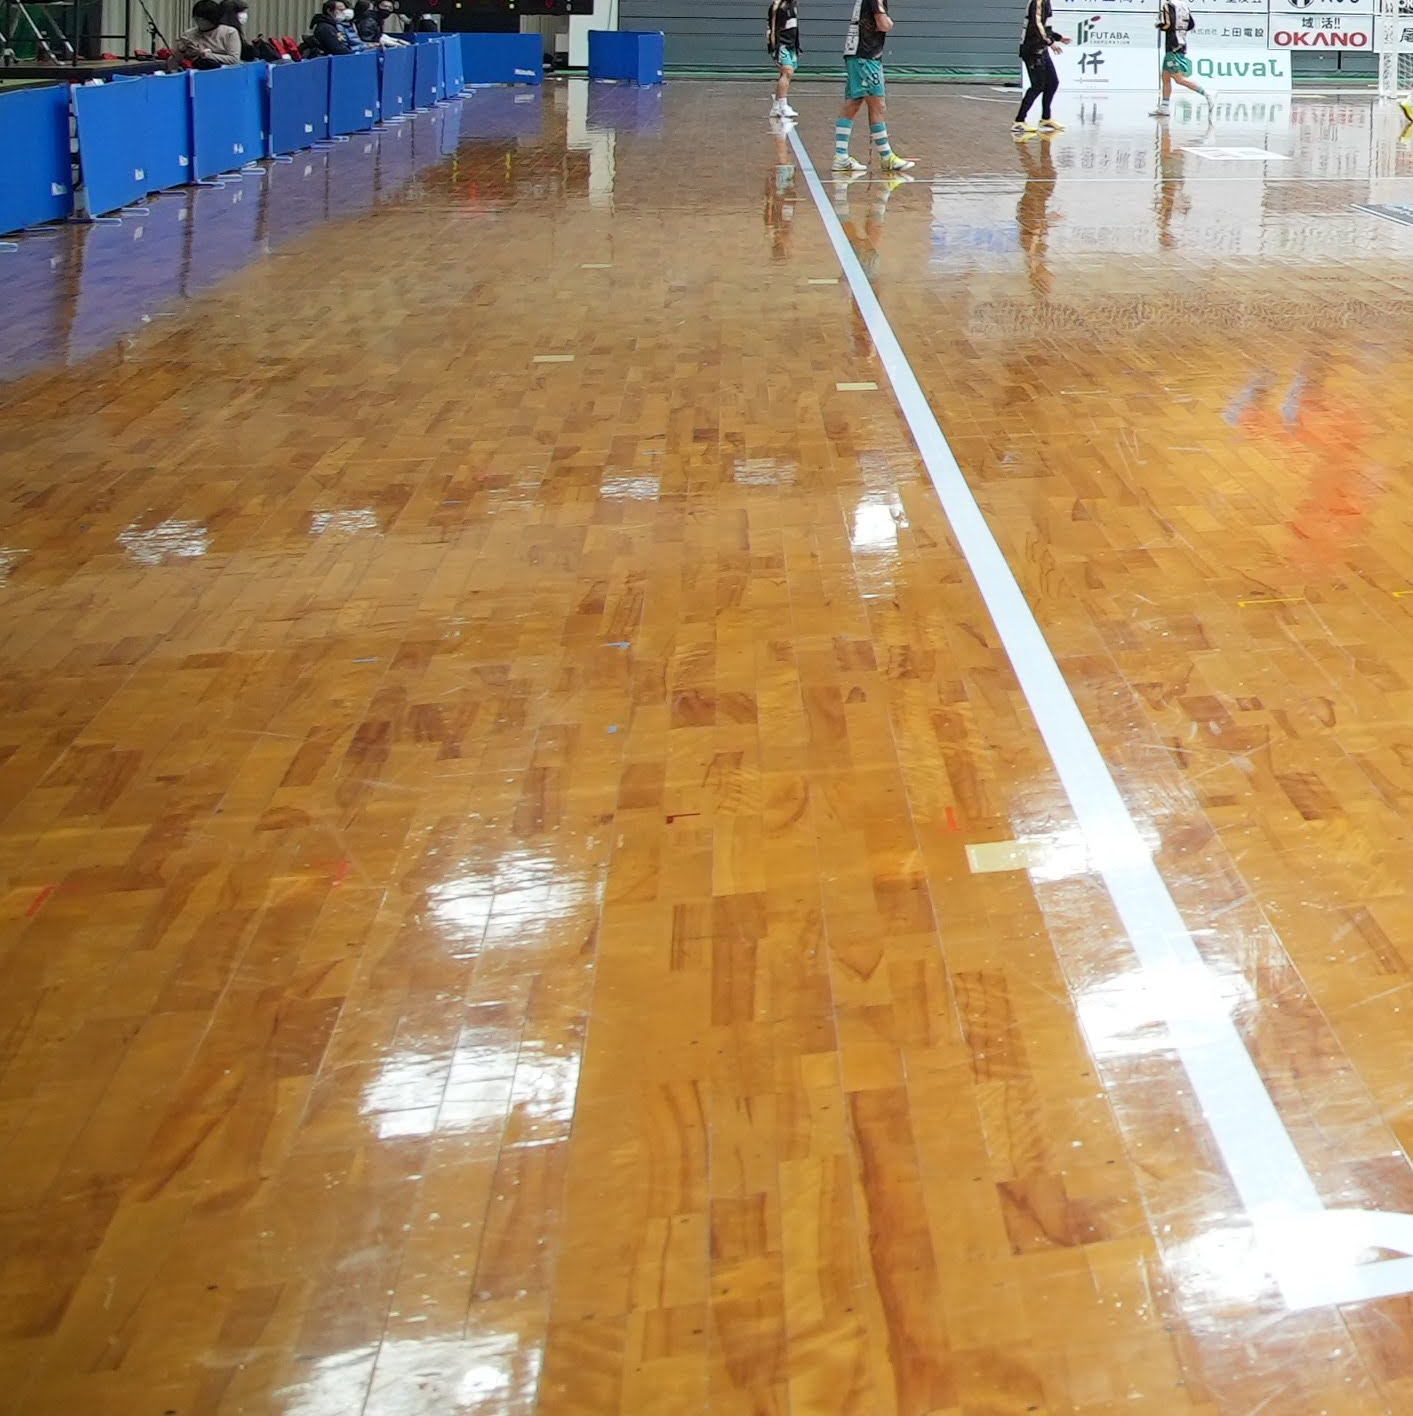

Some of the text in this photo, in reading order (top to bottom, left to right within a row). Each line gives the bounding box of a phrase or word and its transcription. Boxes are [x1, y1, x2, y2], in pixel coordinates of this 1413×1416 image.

[1090, 31, 1130, 40] FUTABA
[1220, 27, 1264, 38] 上田電設
[1273, 31, 1368, 47] OKANO
